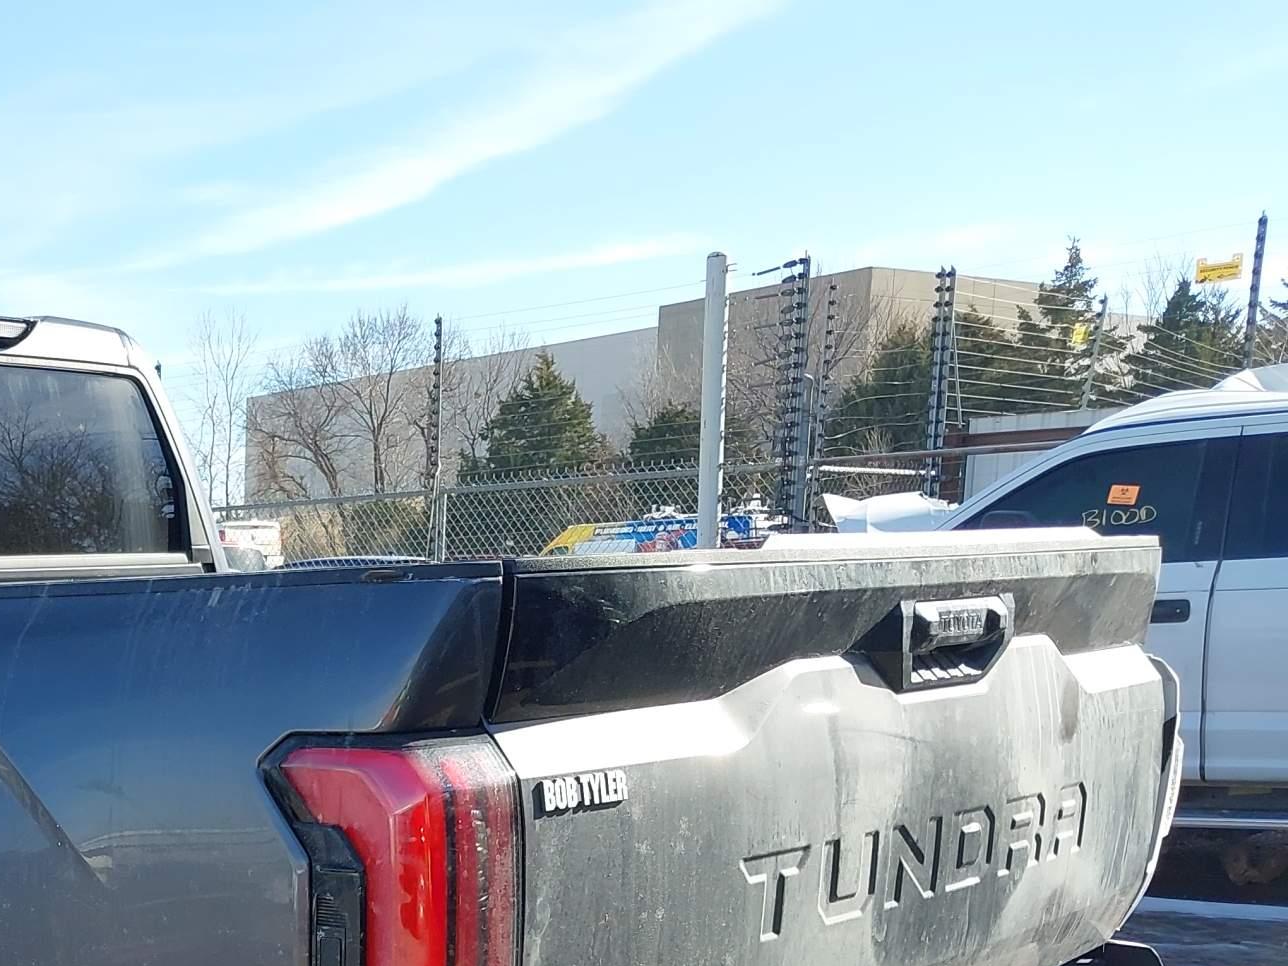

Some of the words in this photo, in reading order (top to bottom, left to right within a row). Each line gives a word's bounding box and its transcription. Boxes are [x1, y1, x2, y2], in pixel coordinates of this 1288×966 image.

[940, 612, 983, 634] TOYOTA
[542, 776, 580, 812] BOB
[577, 769, 629, 806] TYLER
[739, 781, 1088, 942] TUNDRA
